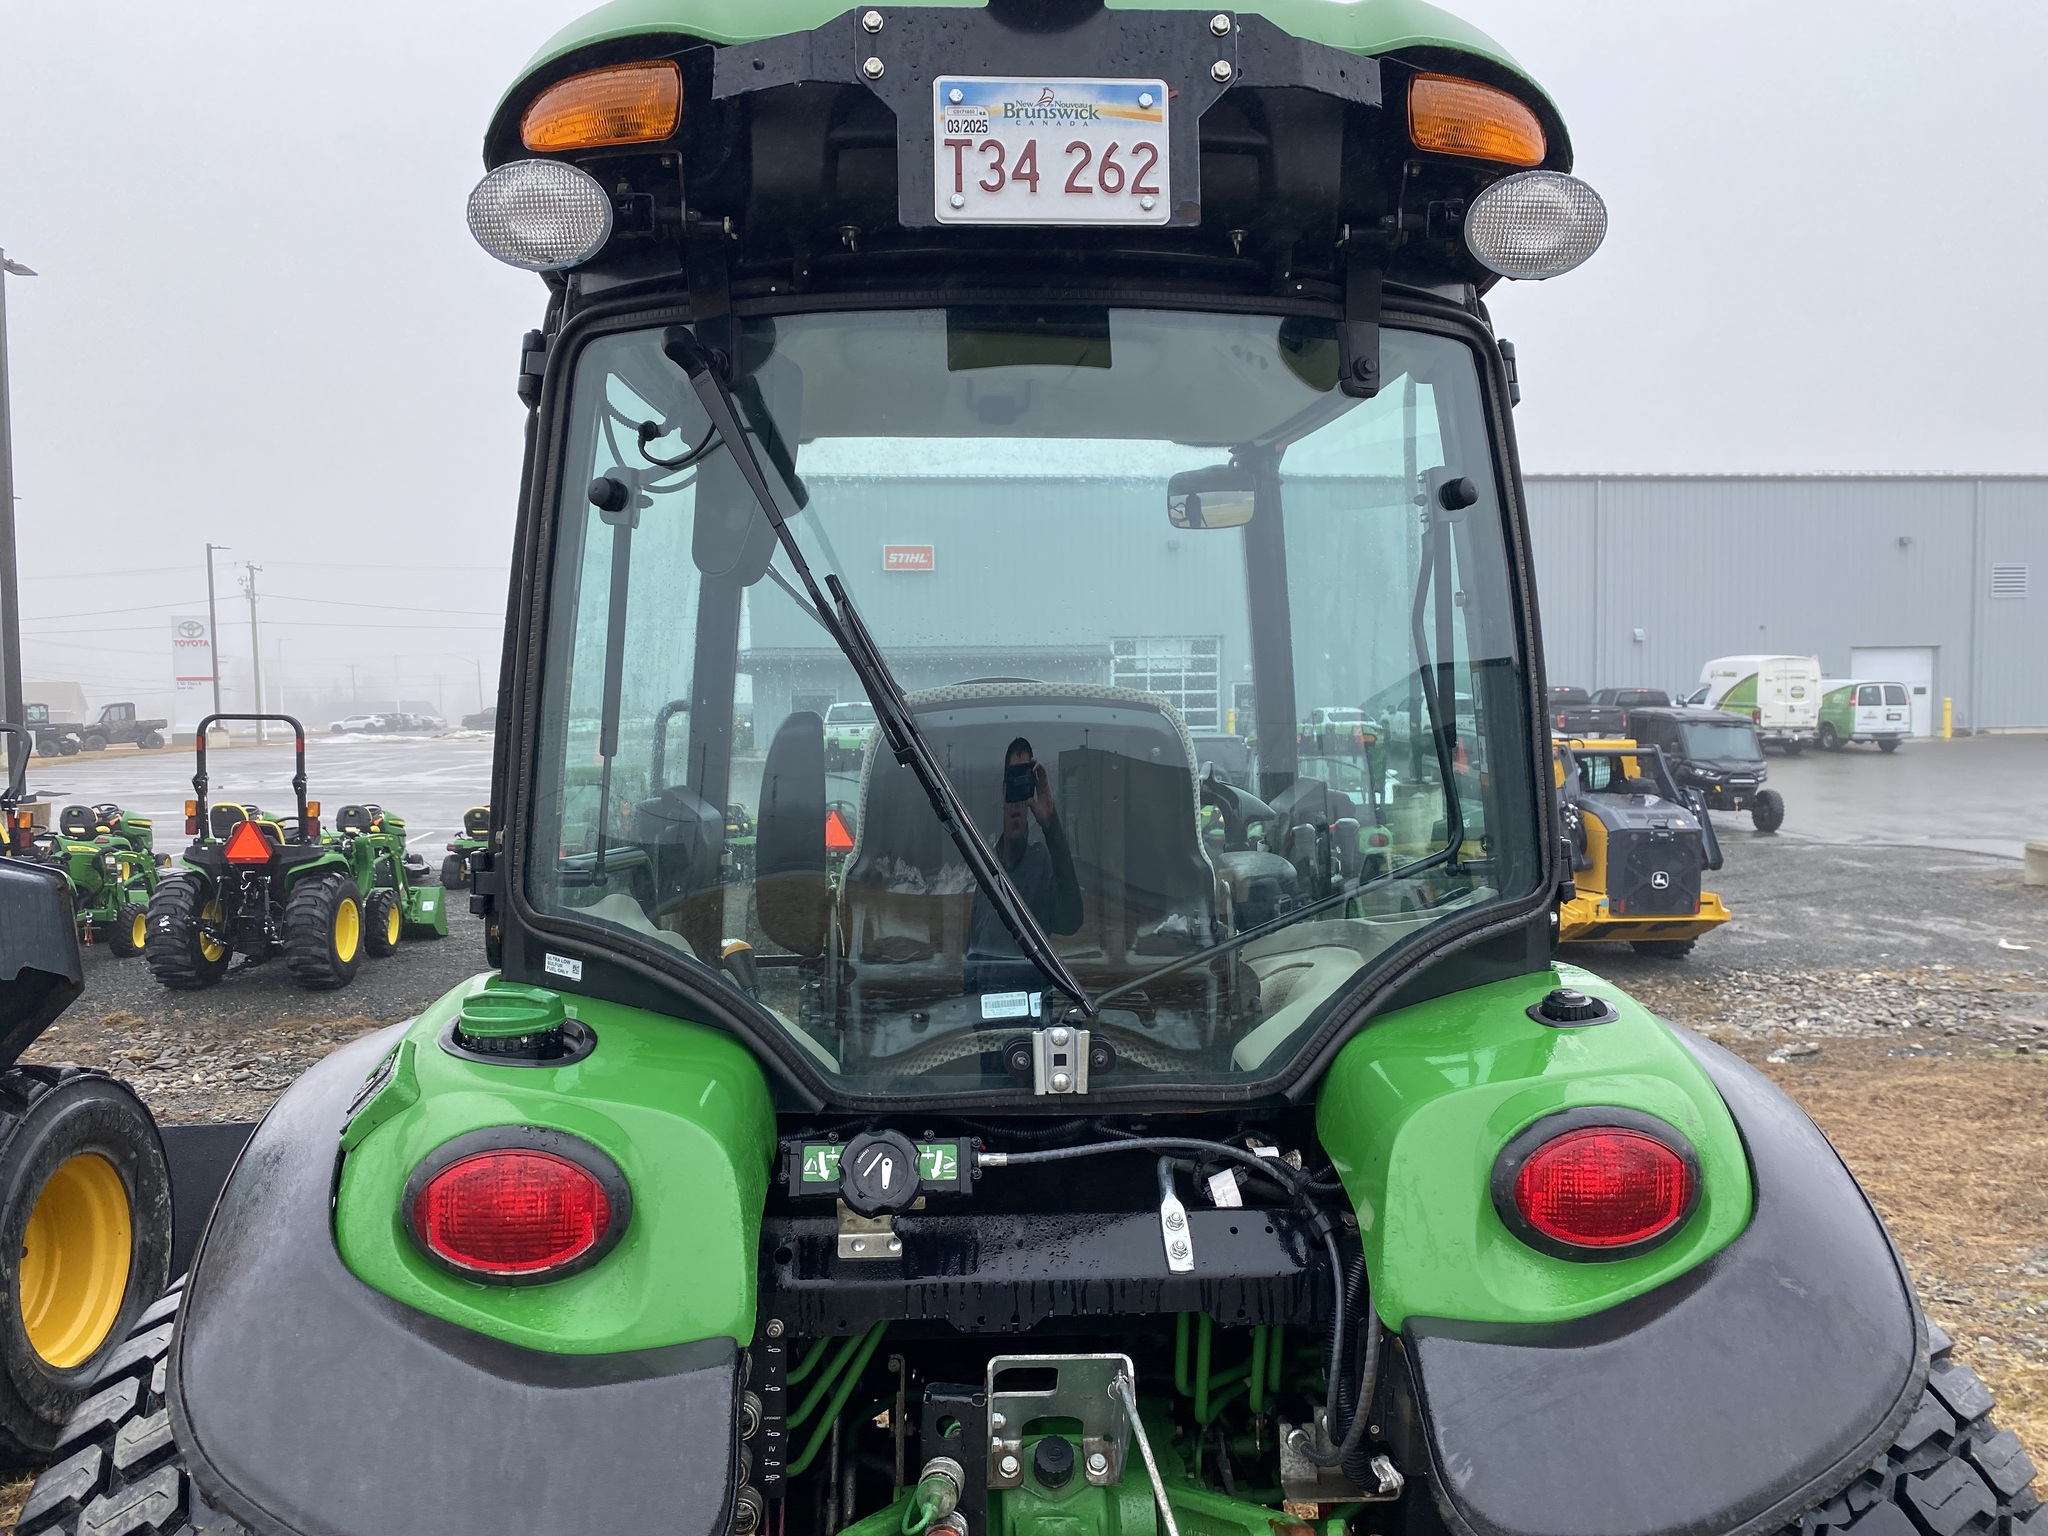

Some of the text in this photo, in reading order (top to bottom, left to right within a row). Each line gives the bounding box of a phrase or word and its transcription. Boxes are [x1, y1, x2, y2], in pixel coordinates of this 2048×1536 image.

[1003, 102, 1100, 120] Brunswick
[947, 119, 988, 133] 03/2025
[944, 138, 1159, 194] T34 262
[888, 553, 926, 563] STIHL
[173, 639, 210, 647] TOYOTA
